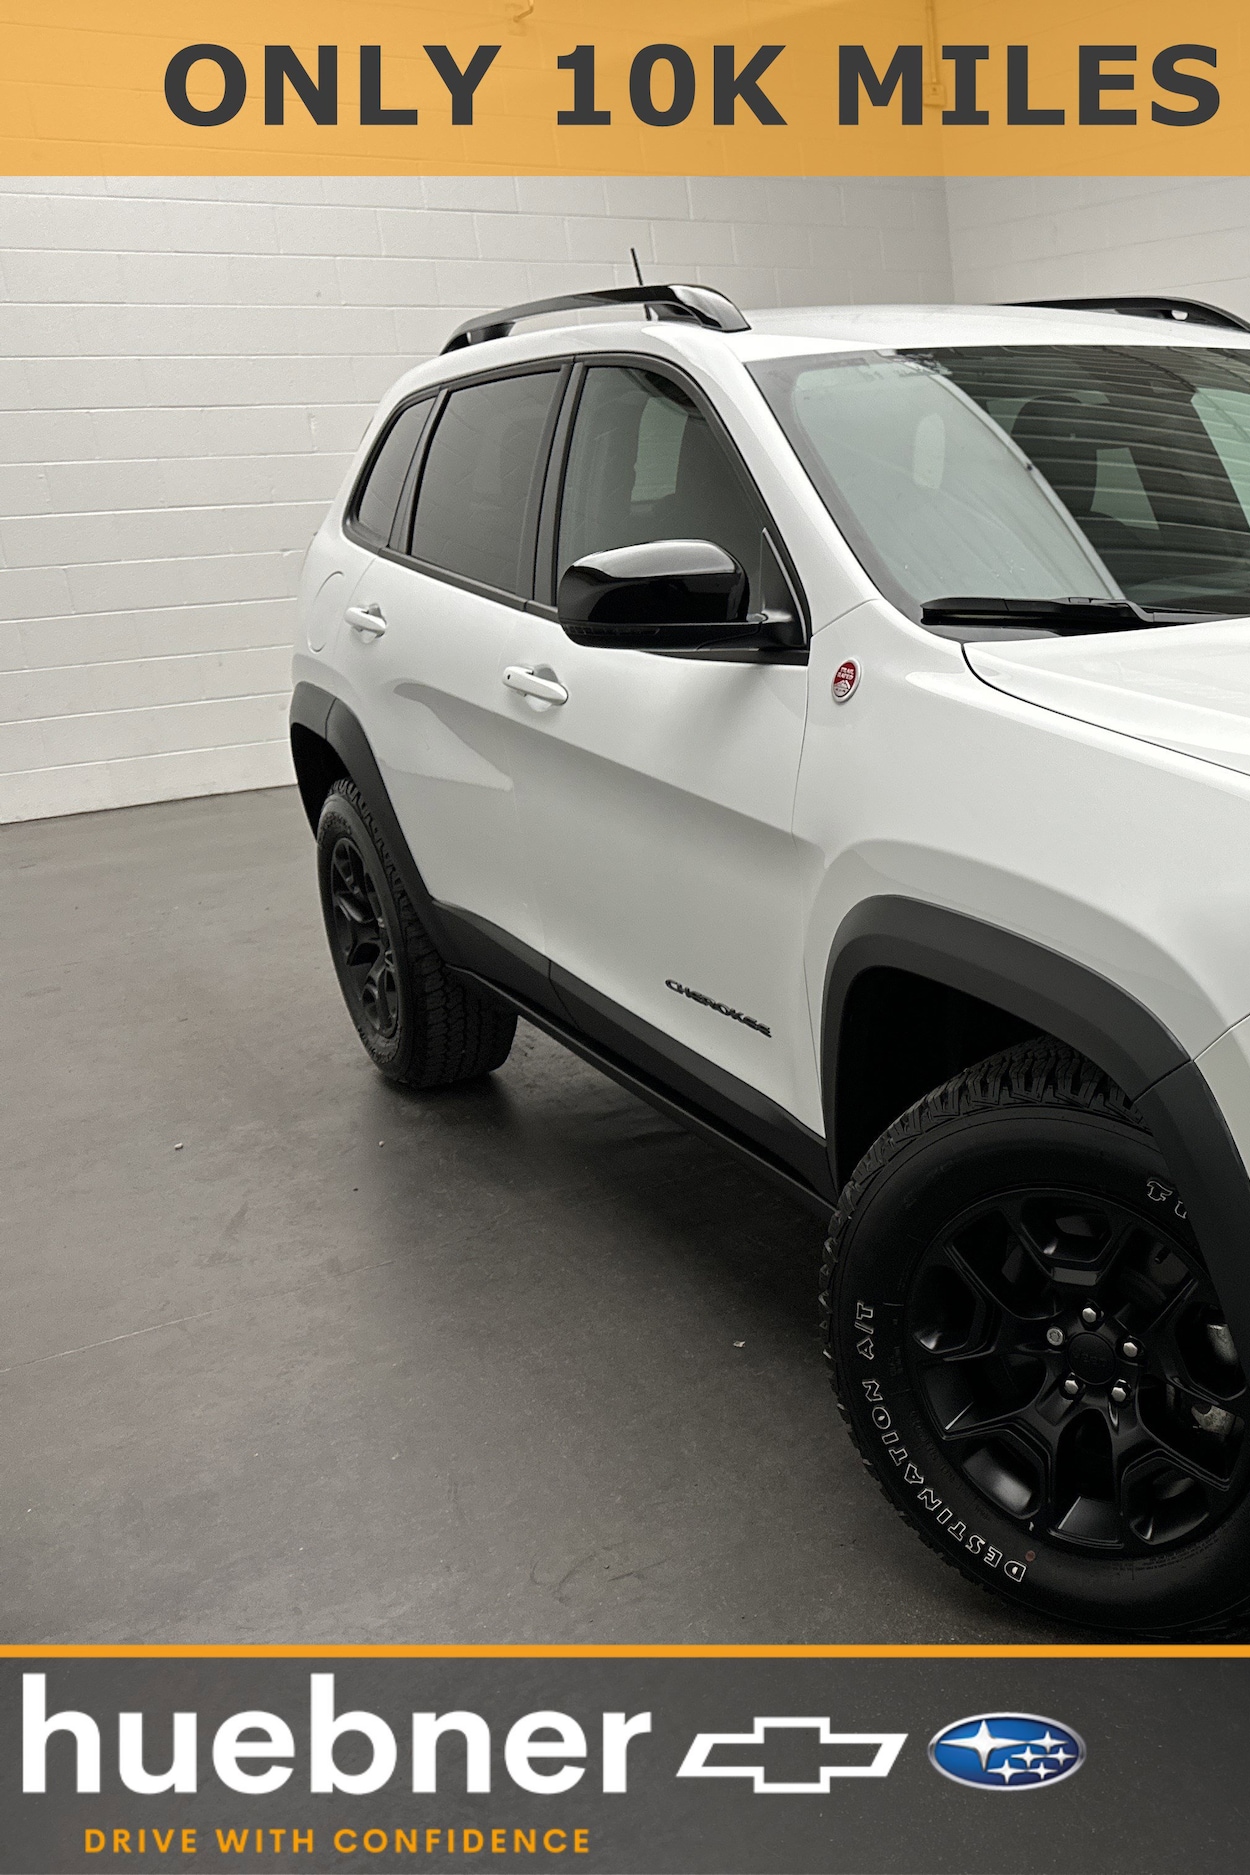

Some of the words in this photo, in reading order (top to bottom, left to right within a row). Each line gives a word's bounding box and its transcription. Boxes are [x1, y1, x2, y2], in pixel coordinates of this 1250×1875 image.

[665, 978, 773, 1039] CHEROKEE
[854, 1300, 875, 1360] A/T
[861, 1379, 1027, 1583] DESTINATION
